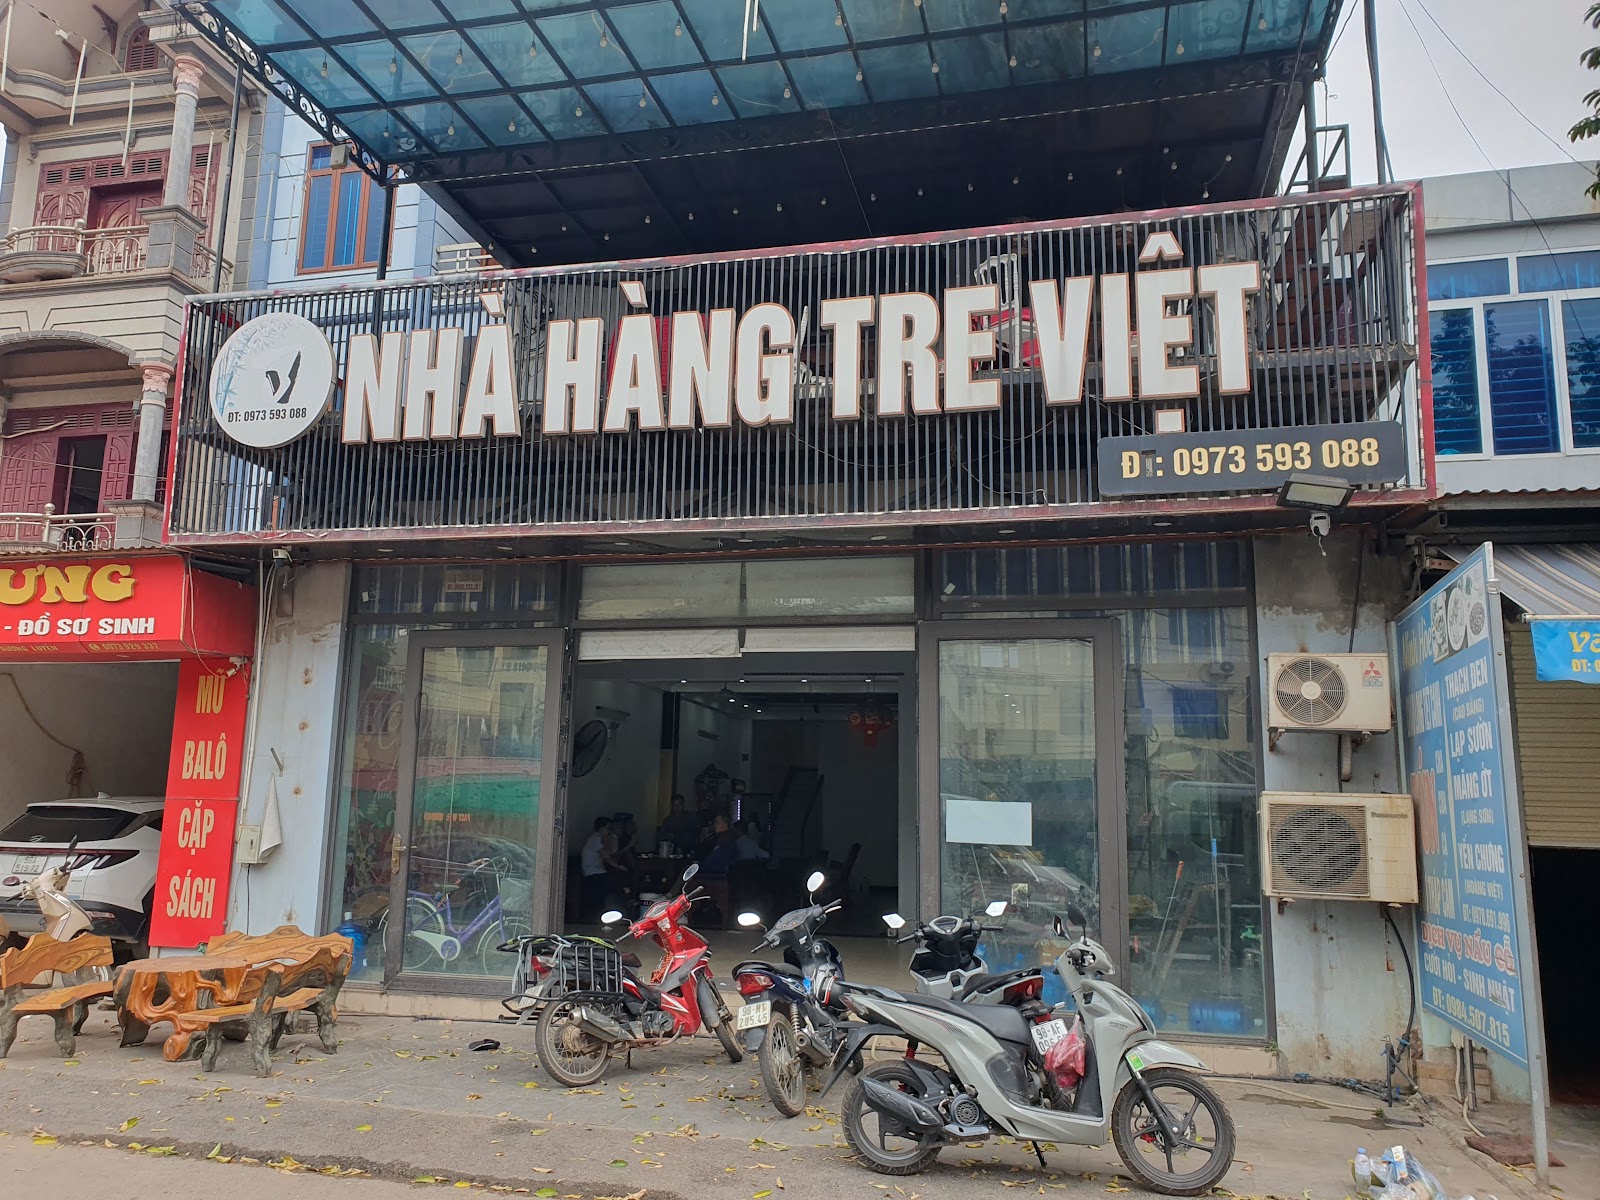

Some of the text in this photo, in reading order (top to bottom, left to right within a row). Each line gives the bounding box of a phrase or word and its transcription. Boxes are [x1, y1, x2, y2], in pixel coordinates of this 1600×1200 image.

[342, 232, 1261, 445] NHÀ HÀNG TRE VIỆT
[228, 407, 307, 423] ĐT: 0973 593 088
[1173, 445, 1246, 476] 0973
[1256, 441, 1312, 472] 593
[1321, 437, 1380, 468] 088
[18, 612, 51, 636] ĐỒ
[57, 617, 91, 636] SƠ
[98, 617, 155, 635] SINH
[196, 666, 225, 714] MŨ
[1445, 666, 1469, 703] THẠCH
[182, 732, 227, 781] BALÔ
[1450, 716, 1493, 764] LẠP SƯỜN
[1452, 761, 1493, 801] MĂNG ỚT
[178, 799, 215, 859] CẶP
[1458, 834, 1474, 870] YẾN
[166, 875, 216, 919] SÁCH
[1445, 928, 1463, 962] VỤ
[1463, 926, 1492, 968] NẤU
[1424, 949, 1440, 978] CƯỚI
[1441, 952, 1457, 985] HỎI
[1463, 968, 1485, 999] SINH
[1487, 976, 1516, 1016] NHẬT
[739, 1013, 768, 1028] 285.45
[1035, 1022, 1061, 1040] 98-AF
[1446, 993, 1509, 1048] 0984.507.815
